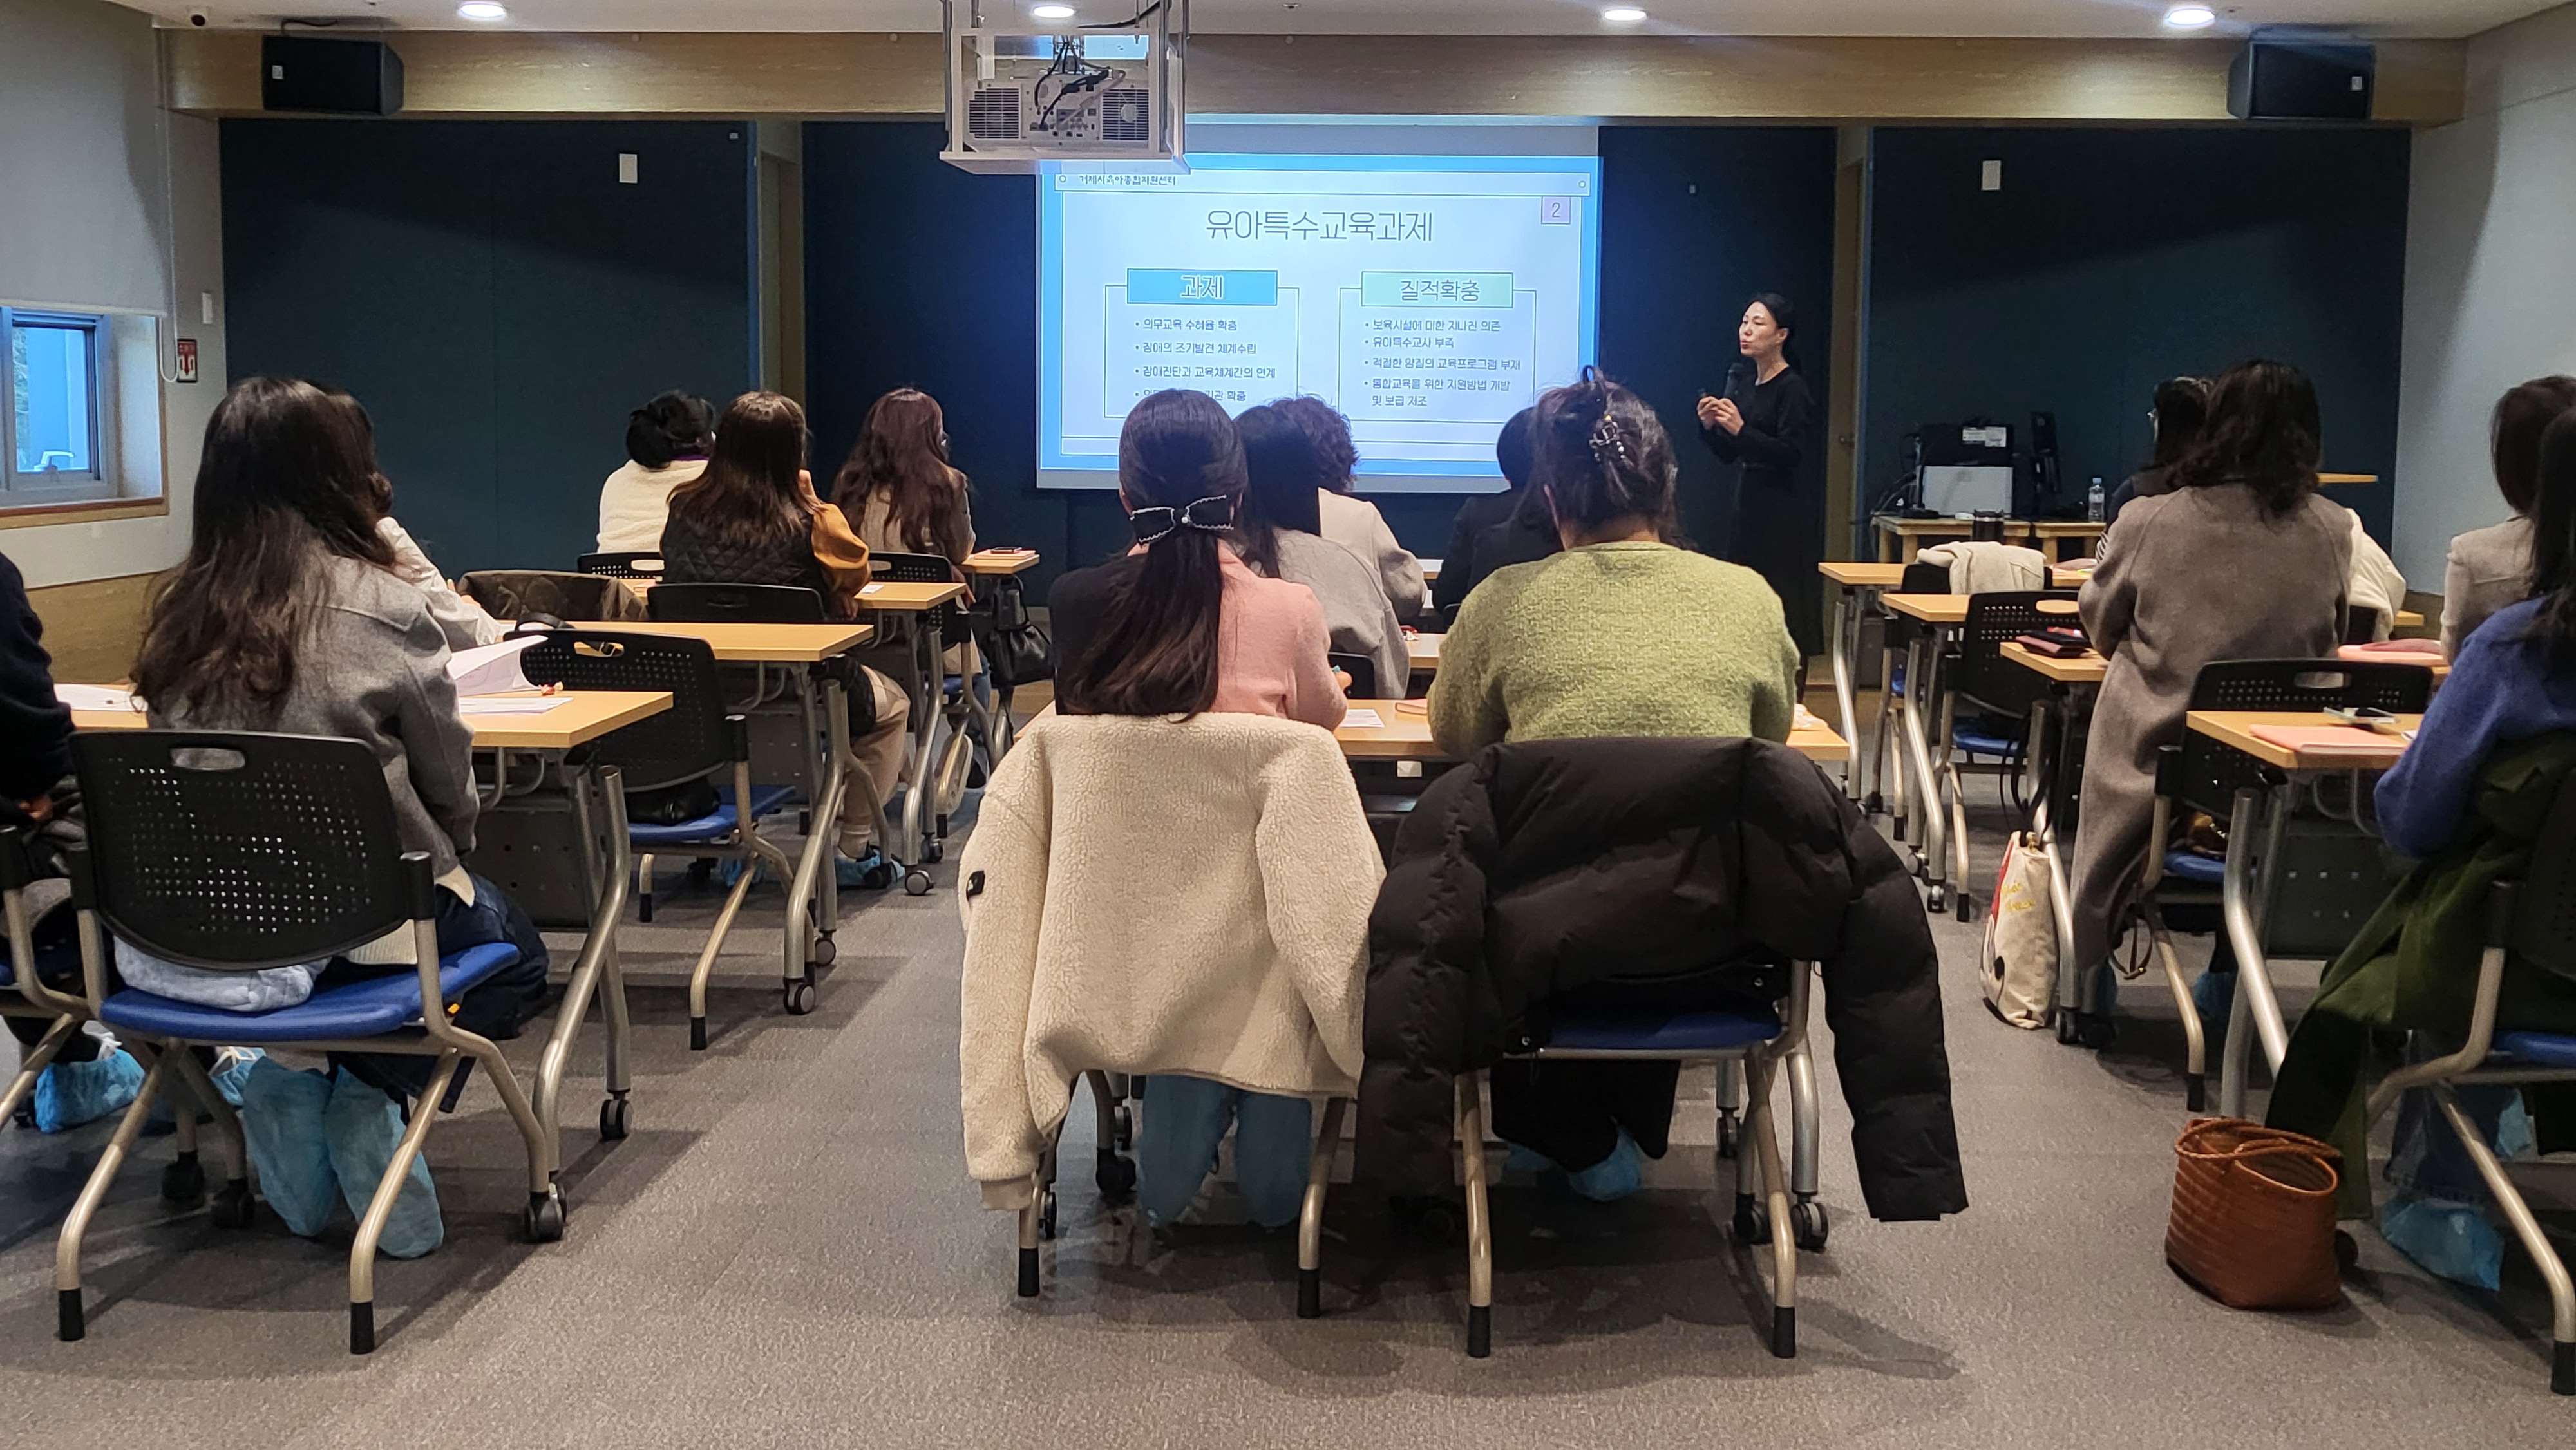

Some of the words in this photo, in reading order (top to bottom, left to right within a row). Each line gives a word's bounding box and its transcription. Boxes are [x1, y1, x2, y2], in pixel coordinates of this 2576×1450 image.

[1551, 203, 1561, 219] 2
[1205, 209, 1434, 242] 유아특수교육과제
[1180, 275, 1224, 300] 과제
[1399, 278, 1481, 303] 질적확충
[1143, 319, 1182, 330] 의무교육
[1218, 320, 1237, 331] 확충
[1373, 319, 1422, 331] 보육시설에
[1425, 320, 1444, 331] 대한
[1448, 321, 1477, 331] 지나친
[1481, 321, 1501, 332] 의존
[1142, 342, 1172, 353] 장애의
[1175, 343, 1214, 353] 조기발견
[1217, 343, 1256, 354] 체계수립
[1435, 337, 1454, 348] 부족
[1373, 357, 1402, 368] 적절한
[1405, 357, 1434, 369] 양질의
[1437, 358, 1497, 370] 교육프로그램
[1501, 359, 1520, 370] 부재
[1142, 366, 1191, 377] 장애진단과
[1195, 366, 1253, 378] 교육체계간의
[1256, 367, 1276, 379] 연계
[1424, 379, 1444, 390] 위한
[1447, 379, 1487, 391] 지원방법
[1490, 380, 1510, 391] 개발
[1227, 390, 1246, 402] 확충
[1372, 395, 1382, 406] 및
[1385, 395, 1405, 406] 보급
[1407, 395, 1427, 406] 저조
